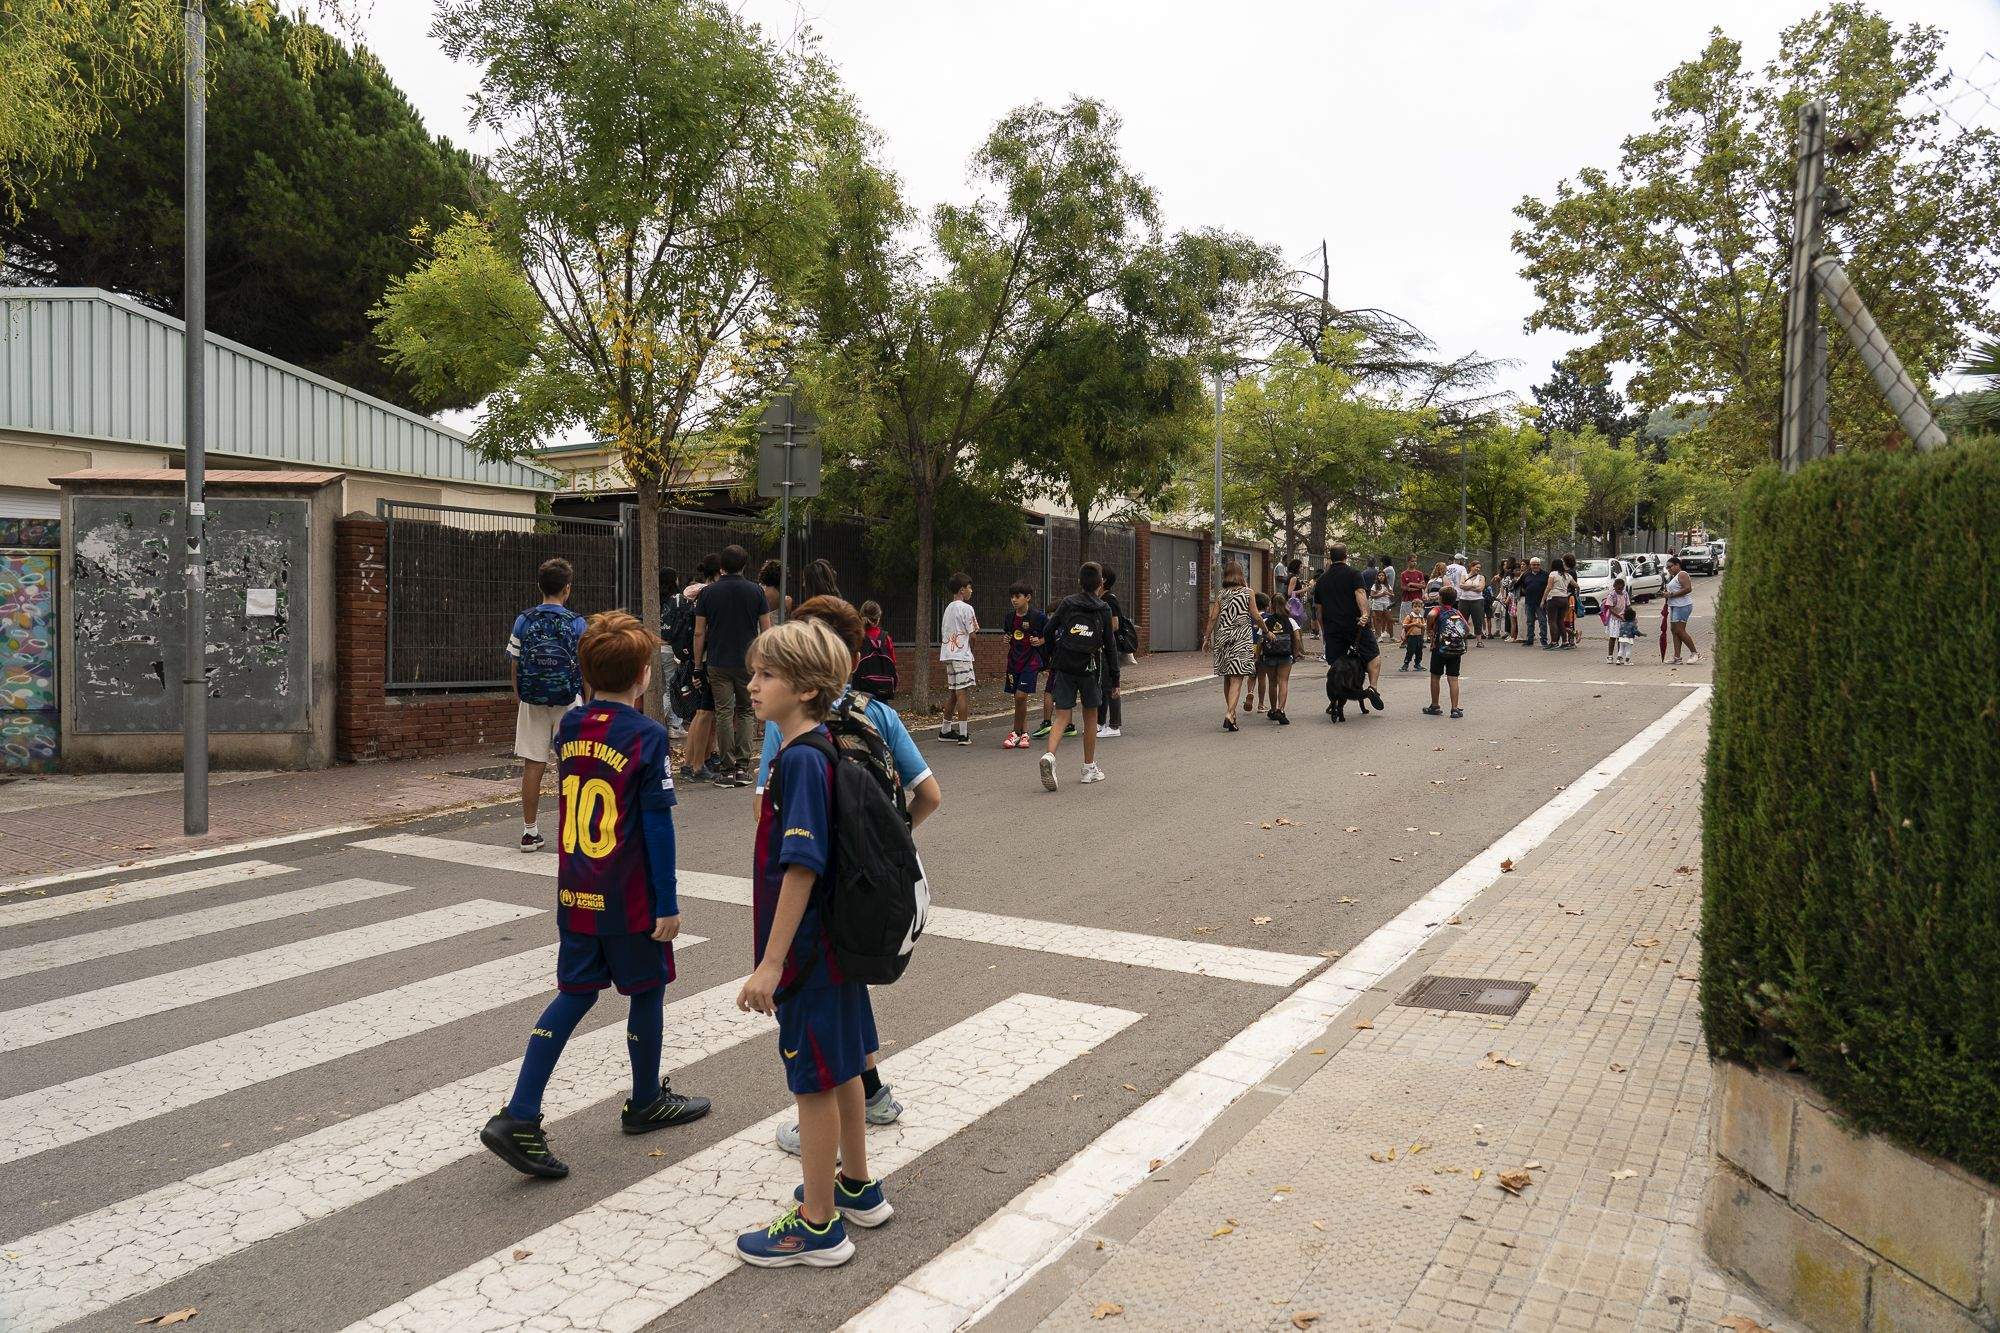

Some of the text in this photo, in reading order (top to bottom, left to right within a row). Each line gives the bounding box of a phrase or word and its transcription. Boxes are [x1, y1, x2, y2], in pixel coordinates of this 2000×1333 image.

[560, 740, 630, 773] AMINE YAMAL
[562, 775, 618, 858] 10
[575, 891, 605, 902] UNHCR
[576, 898, 605, 908] ACNUR
[532, 1027, 553, 1039] ARÇA
